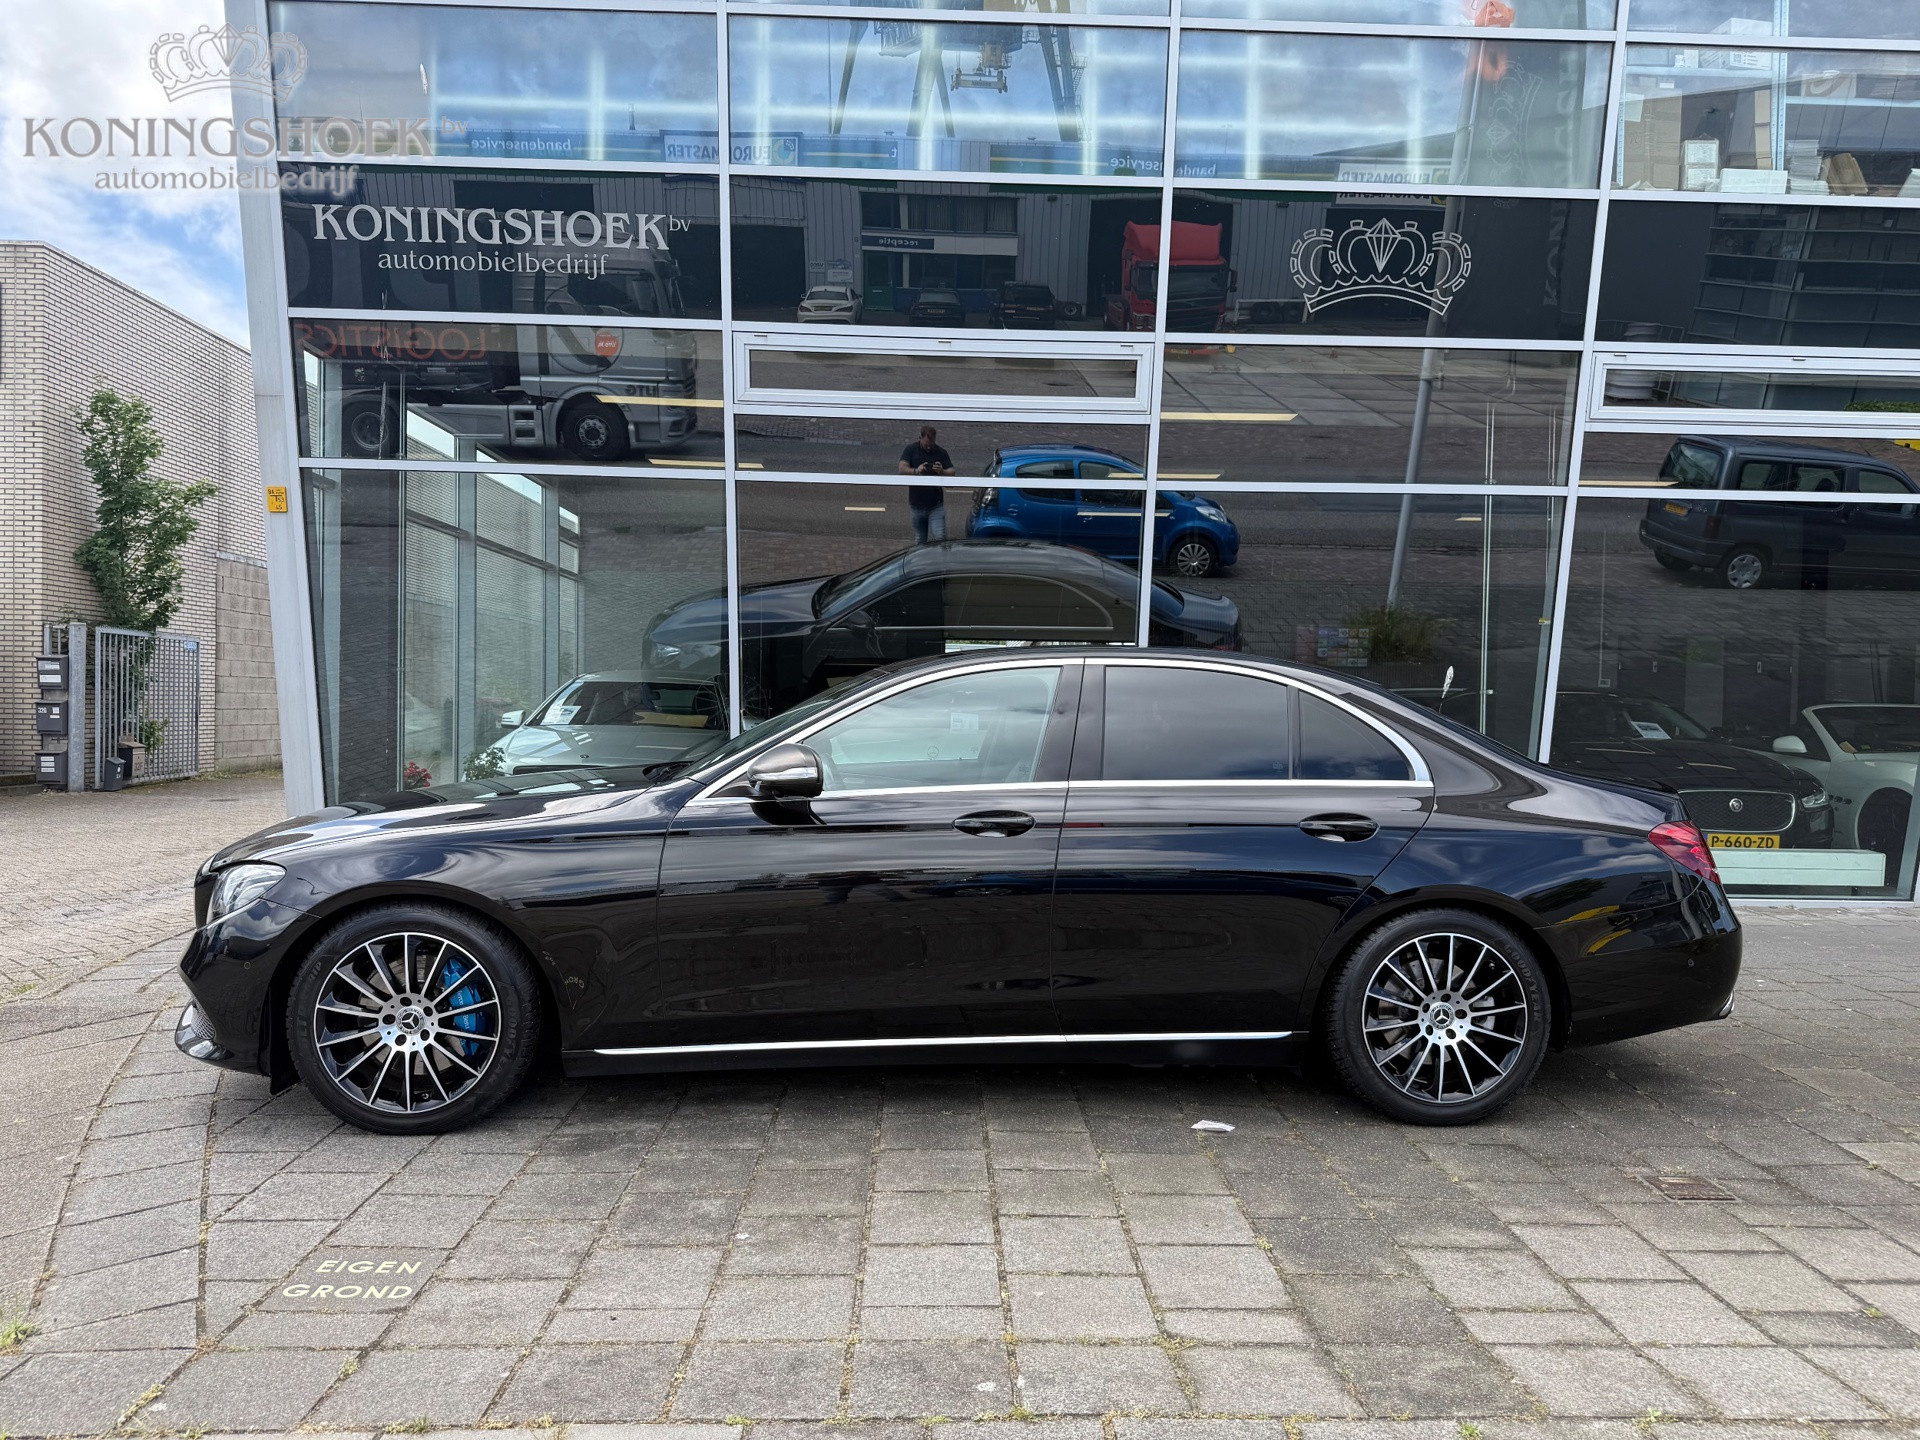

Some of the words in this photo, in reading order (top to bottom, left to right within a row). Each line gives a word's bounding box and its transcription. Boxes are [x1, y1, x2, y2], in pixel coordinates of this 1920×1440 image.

[311, 203, 670, 250] KONINGSHOEK
[669, 215, 692, 232] bv
[378, 250, 609, 280] automobielbedrijf
[1711, 836, 1775, 849] P-660-ZD
[315, 1260, 422, 1274] EIGEN
[282, 1284, 413, 1299] GROND
